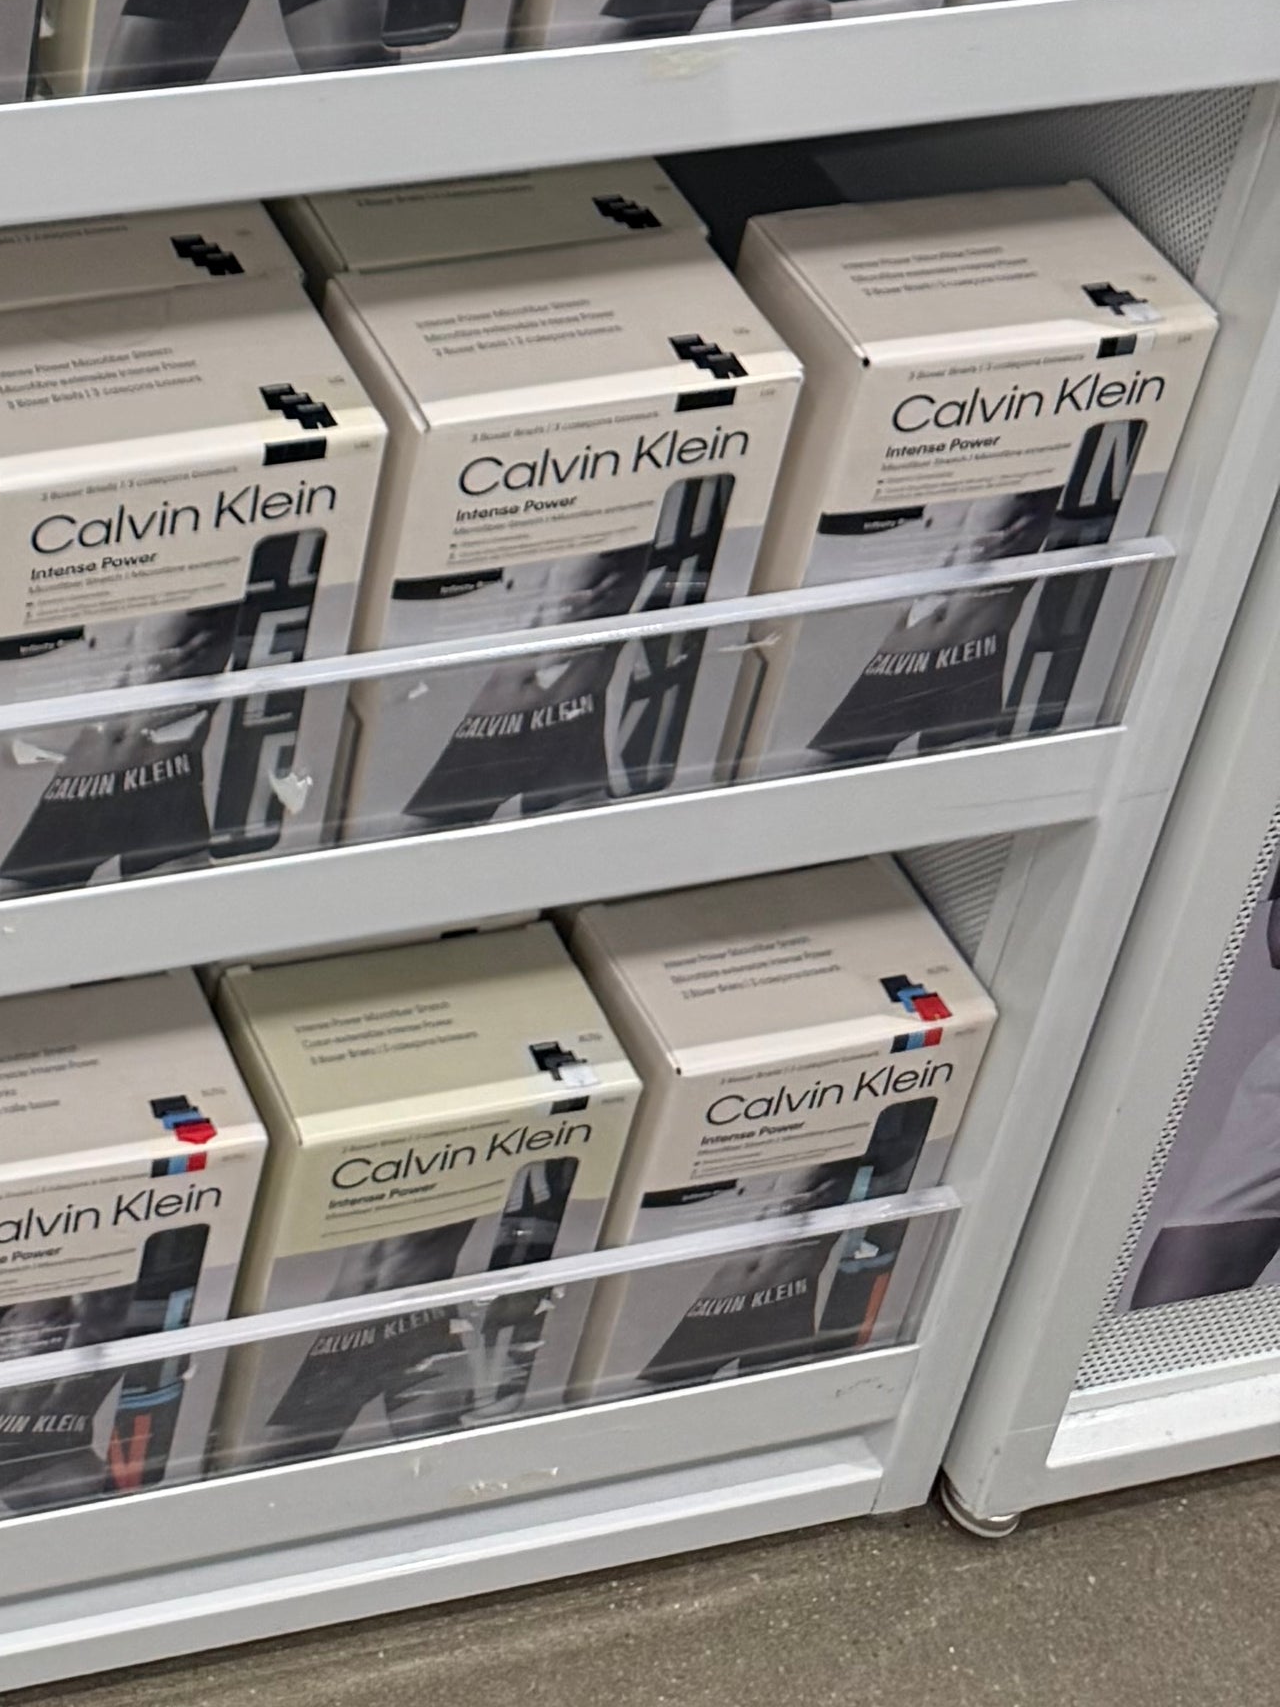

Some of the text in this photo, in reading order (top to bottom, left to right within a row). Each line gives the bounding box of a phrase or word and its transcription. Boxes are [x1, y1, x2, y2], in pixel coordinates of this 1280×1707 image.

[892, 370, 1165, 433] Calvin Klein
[459, 426, 749, 496] Calvin Klein
[31, 480, 336, 554] Calvin Klein
[706, 1059, 954, 1126] Calvin Klein
[331, 1119, 593, 1193] Calvin Klein
[111, 1183, 223, 1227] Klein
